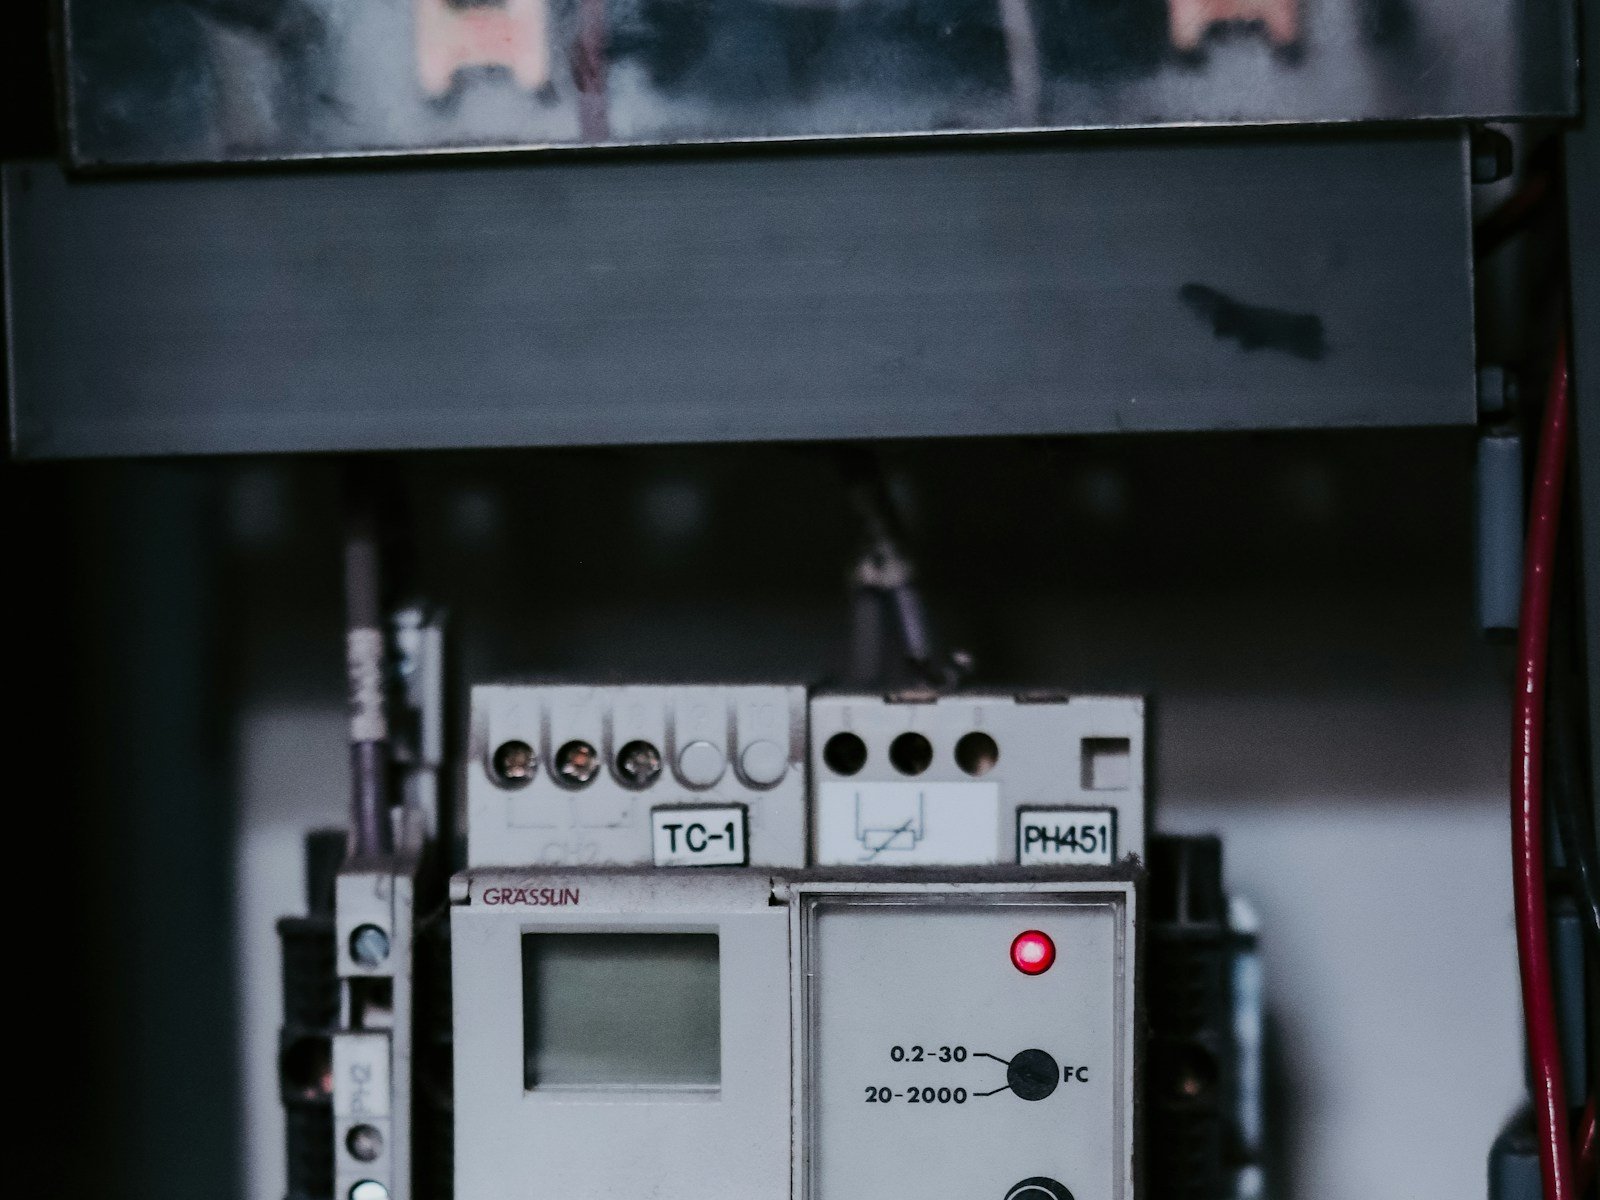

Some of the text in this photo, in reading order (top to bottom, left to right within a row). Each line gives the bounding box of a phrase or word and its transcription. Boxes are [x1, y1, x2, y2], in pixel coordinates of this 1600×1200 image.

[662, 822, 735, 853] TC-1
[1024, 824, 1107, 854] PH451
[483, 886, 580, 906] GRÄSSLIN
[890, 1045, 968, 1063] 0.2-30
[1063, 1066, 1089, 1083] FC
[864, 1086, 968, 1104] 20-2000
